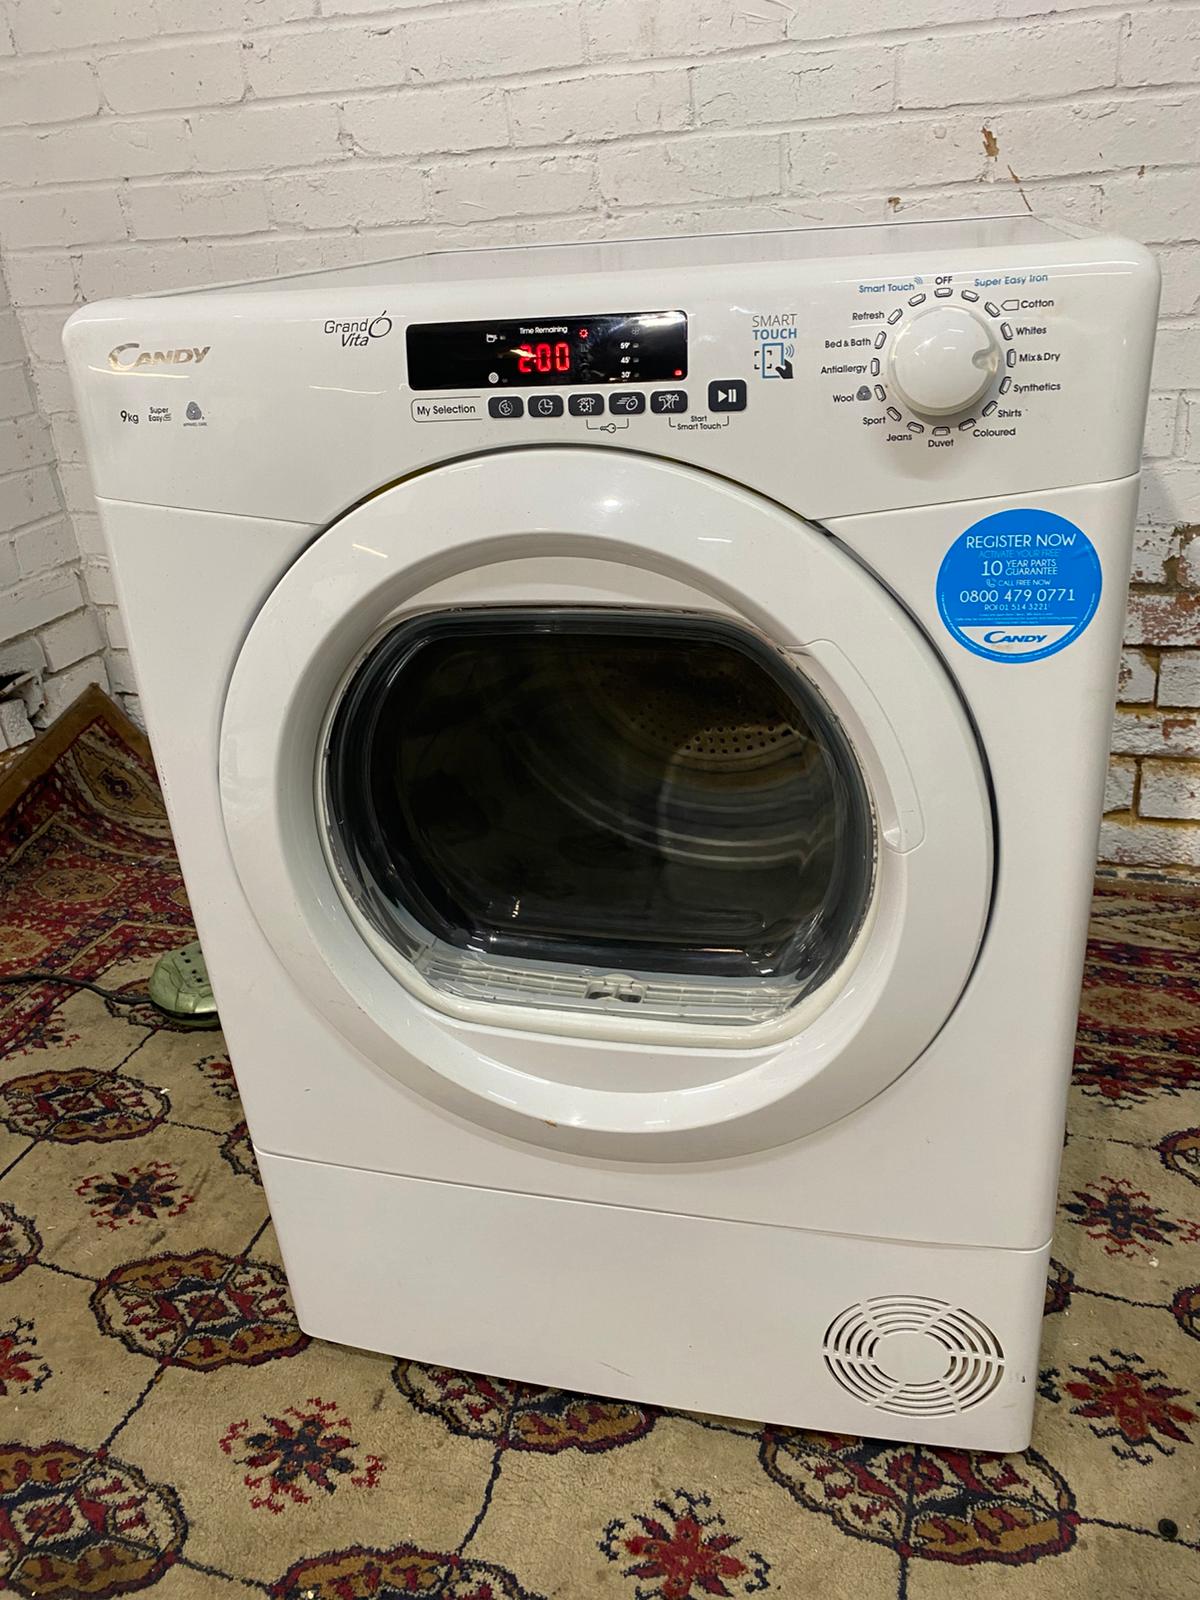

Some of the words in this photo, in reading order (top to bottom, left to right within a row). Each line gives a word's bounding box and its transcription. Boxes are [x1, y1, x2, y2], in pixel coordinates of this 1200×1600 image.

[935, 276, 953, 285] OFF
[974, 277, 1002, 288] Super
[1005, 276, 1026, 286] Easy
[1029, 274, 1048, 283] Iron
[858, 284, 885, 294] Smart
[887, 282, 915, 292] Touch
[1021, 298, 1054, 308] Cotton
[752, 314, 797, 328] SMART
[852, 311, 885, 321] Refresh
[535, 326, 568, 334] Remaining
[753, 328, 797, 340] TOUCH
[1016, 326, 1047, 335] Whites
[341, 334, 369, 347] Vita
[825, 340, 842, 348] Bed
[844, 339, 849, 347] &
[850, 338, 871, 347] Bath
[820, 364, 867, 375] Antiallergy
[1013, 382, 1061, 393] Synthetics
[832, 393, 854, 403] Wool
[417, 405, 432, 416] My
[433, 404, 476, 415] Selection
[998, 408, 1022, 418] Shirts
[120, 410, 139, 424] 9kg
[690, 415, 708, 423] Start
[863, 416, 886, 426] Sport
[677, 423, 699, 431] Smart
[700, 422, 721, 430] Touch
[886, 433, 913, 442] Jeans
[973, 428, 1016, 437] Coloured
[928, 439, 954, 448] Duvet
[967, 535, 1031, 548] REGISTER
[1036, 533, 1077, 547] NOW
[981, 560, 1003, 576] 10
[1031, 559, 1056, 567] PARTS
[1005, 567, 1058, 576] GUARANTEE
[960, 590, 998, 603] 0800
[1004, 589, 1032, 602] 479
[1036, 588, 1075, 602] 0771
[983, 631, 1047, 643] CANDY
